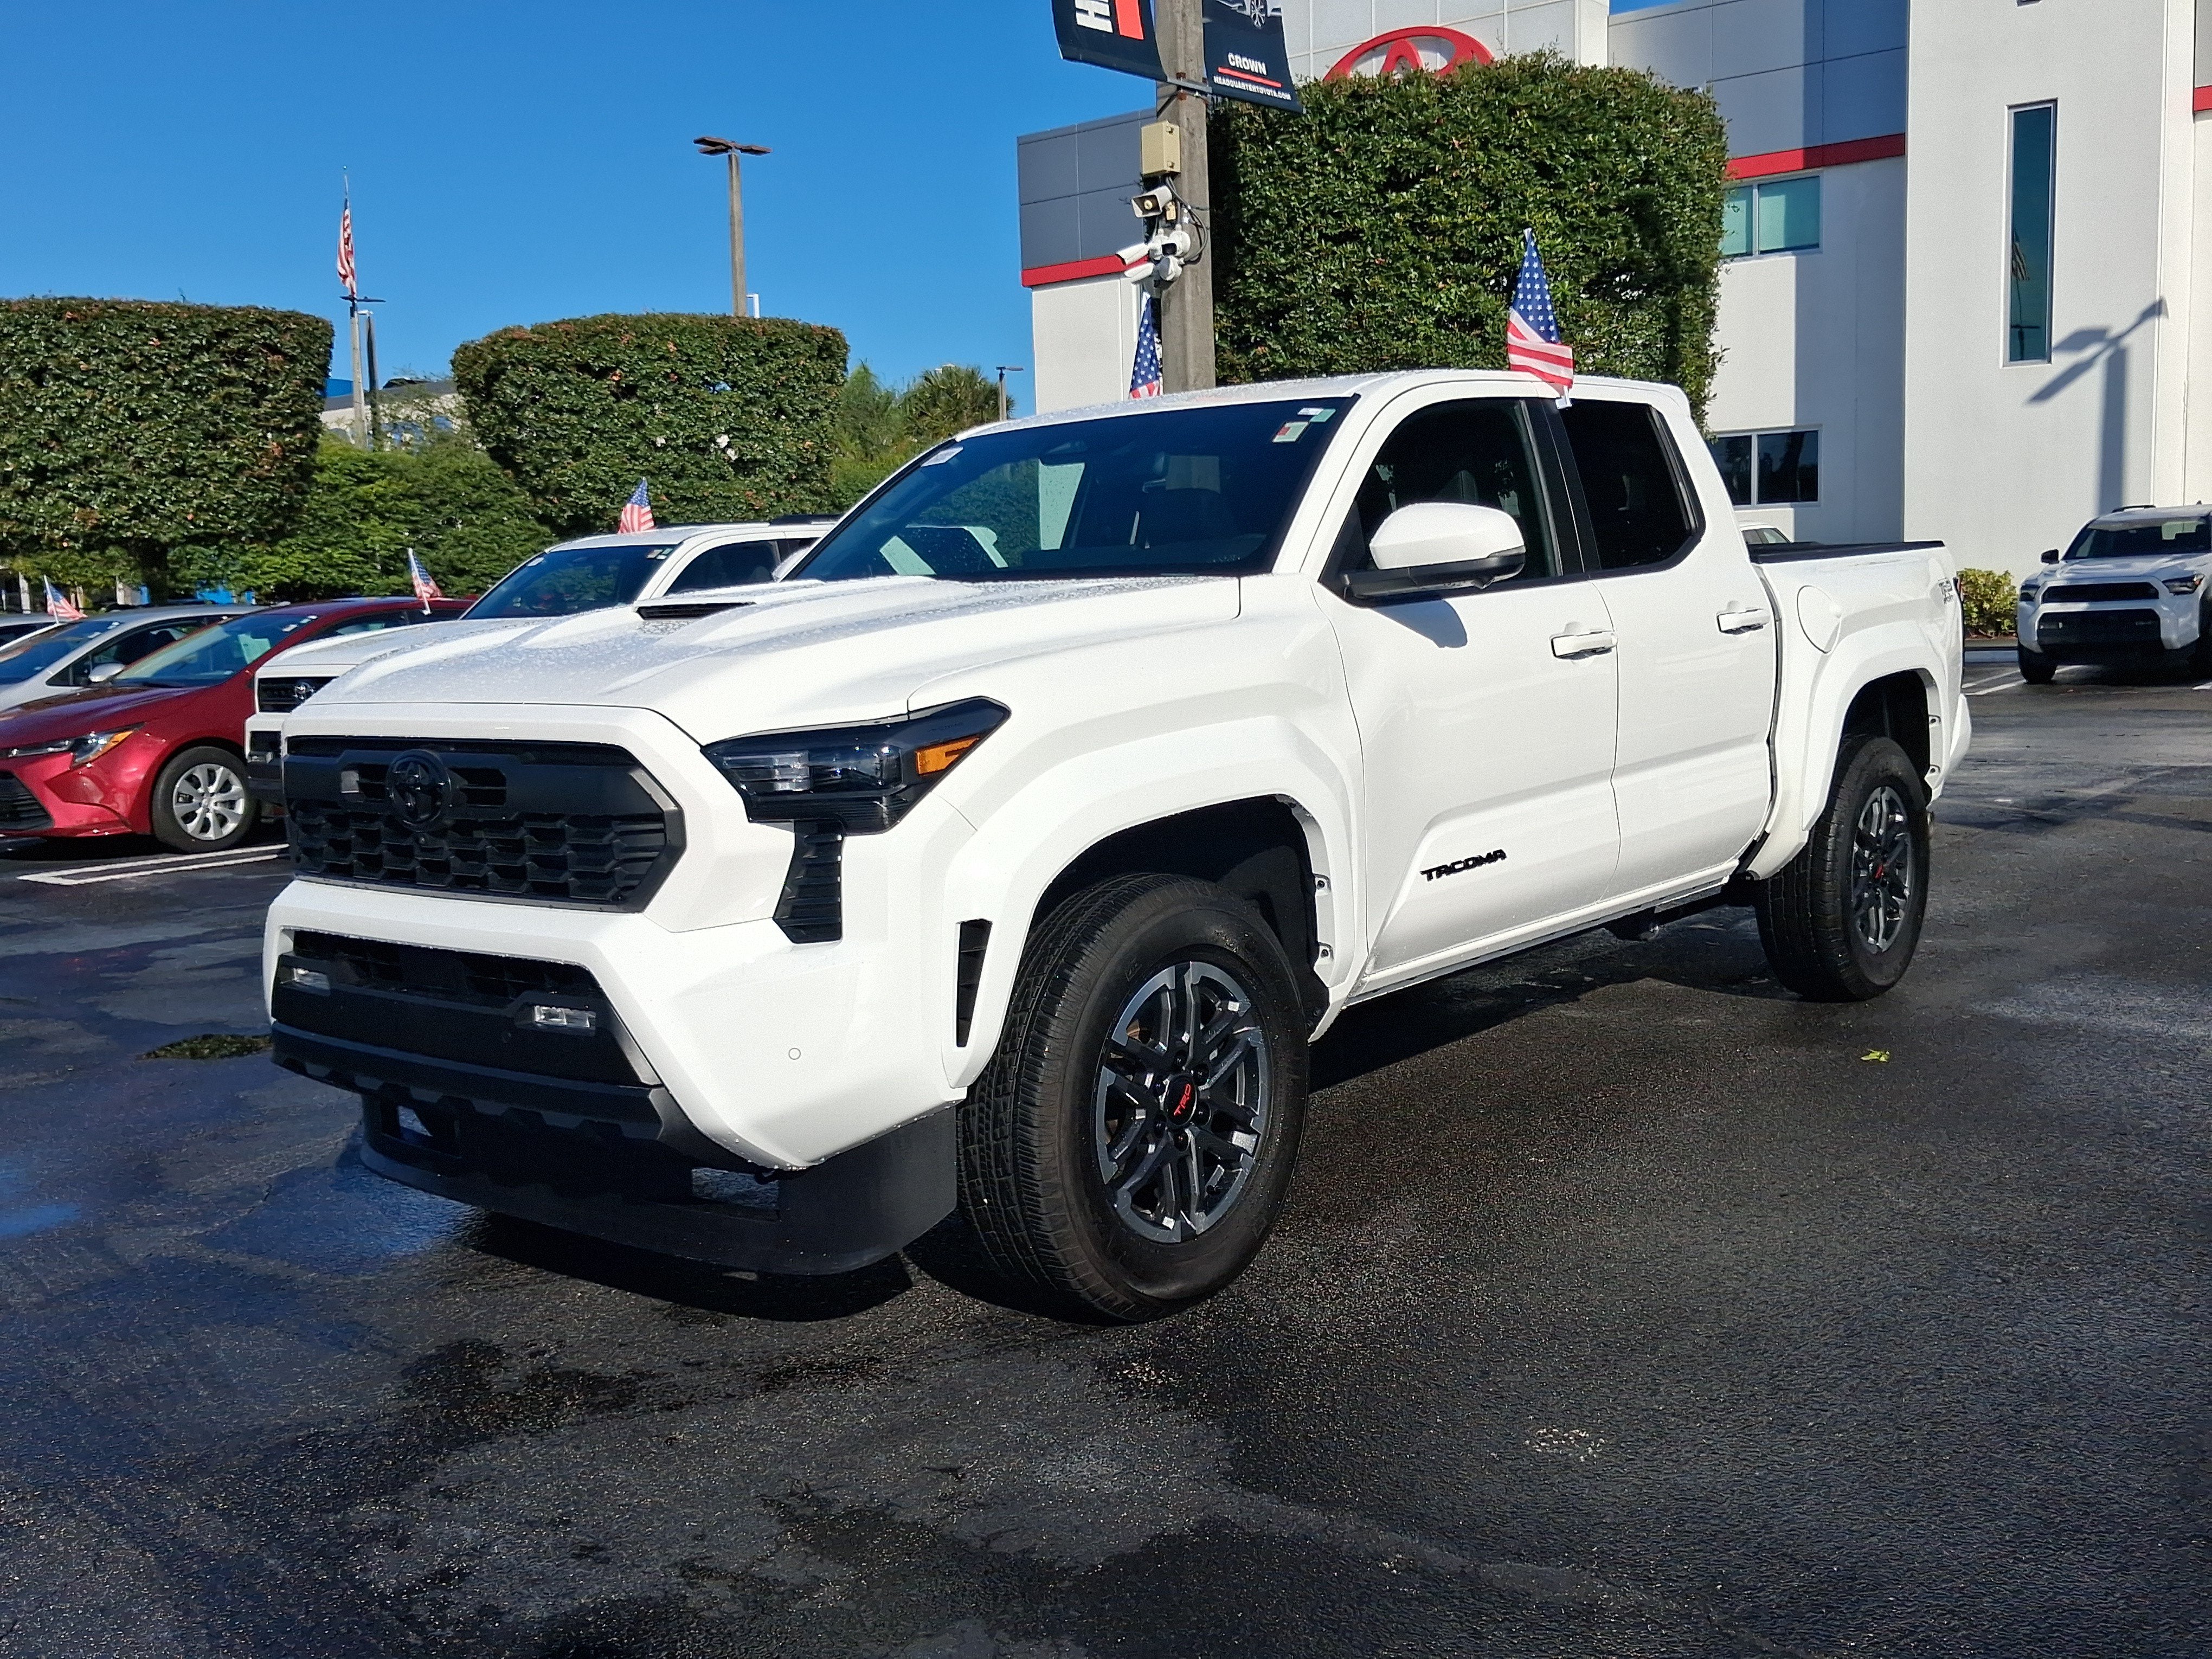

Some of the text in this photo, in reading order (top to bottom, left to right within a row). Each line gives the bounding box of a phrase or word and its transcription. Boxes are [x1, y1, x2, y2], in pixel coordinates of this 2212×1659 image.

[1228, 52, 1267, 75] CROWN
[1213, 75, 1291, 101] HEADQUARTERTOYOTA.COM
[1419, 849, 1507, 882] TACOMA
[1174, 1083, 1191, 1116] TRD
